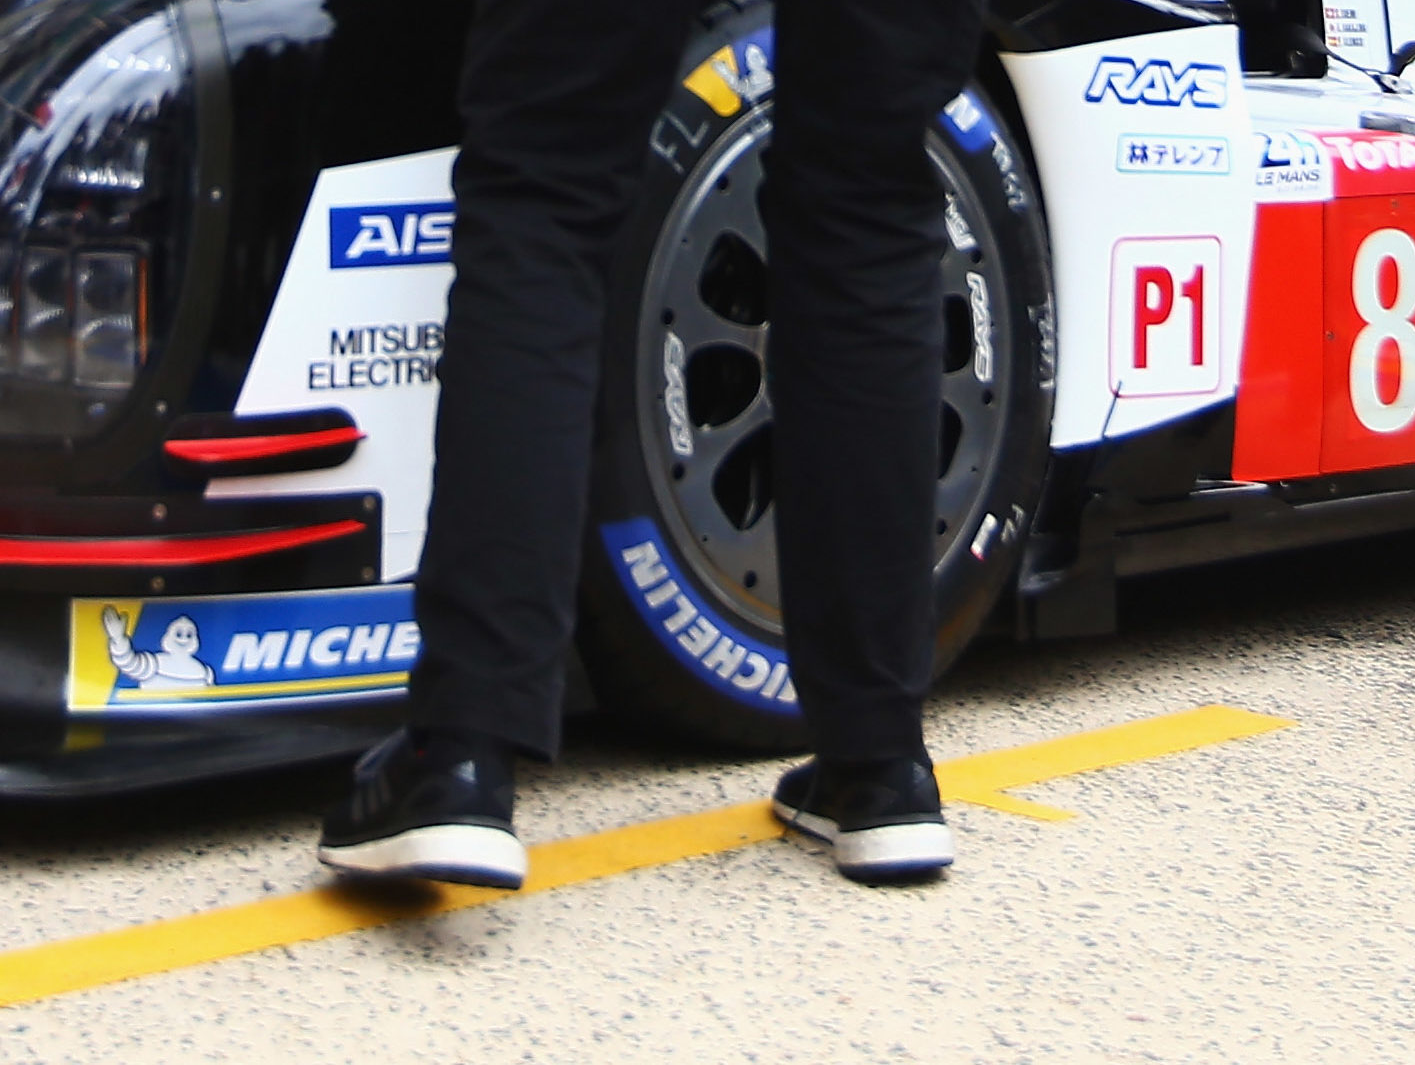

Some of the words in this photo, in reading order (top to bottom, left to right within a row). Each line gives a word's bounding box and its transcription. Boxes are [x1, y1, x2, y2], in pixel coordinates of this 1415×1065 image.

[1084, 55, 1228, 109] RAYS
[1255, 171, 1274, 186] LE
[1275, 168, 1321, 184] MANS
[1131, 264, 1205, 371] P1
